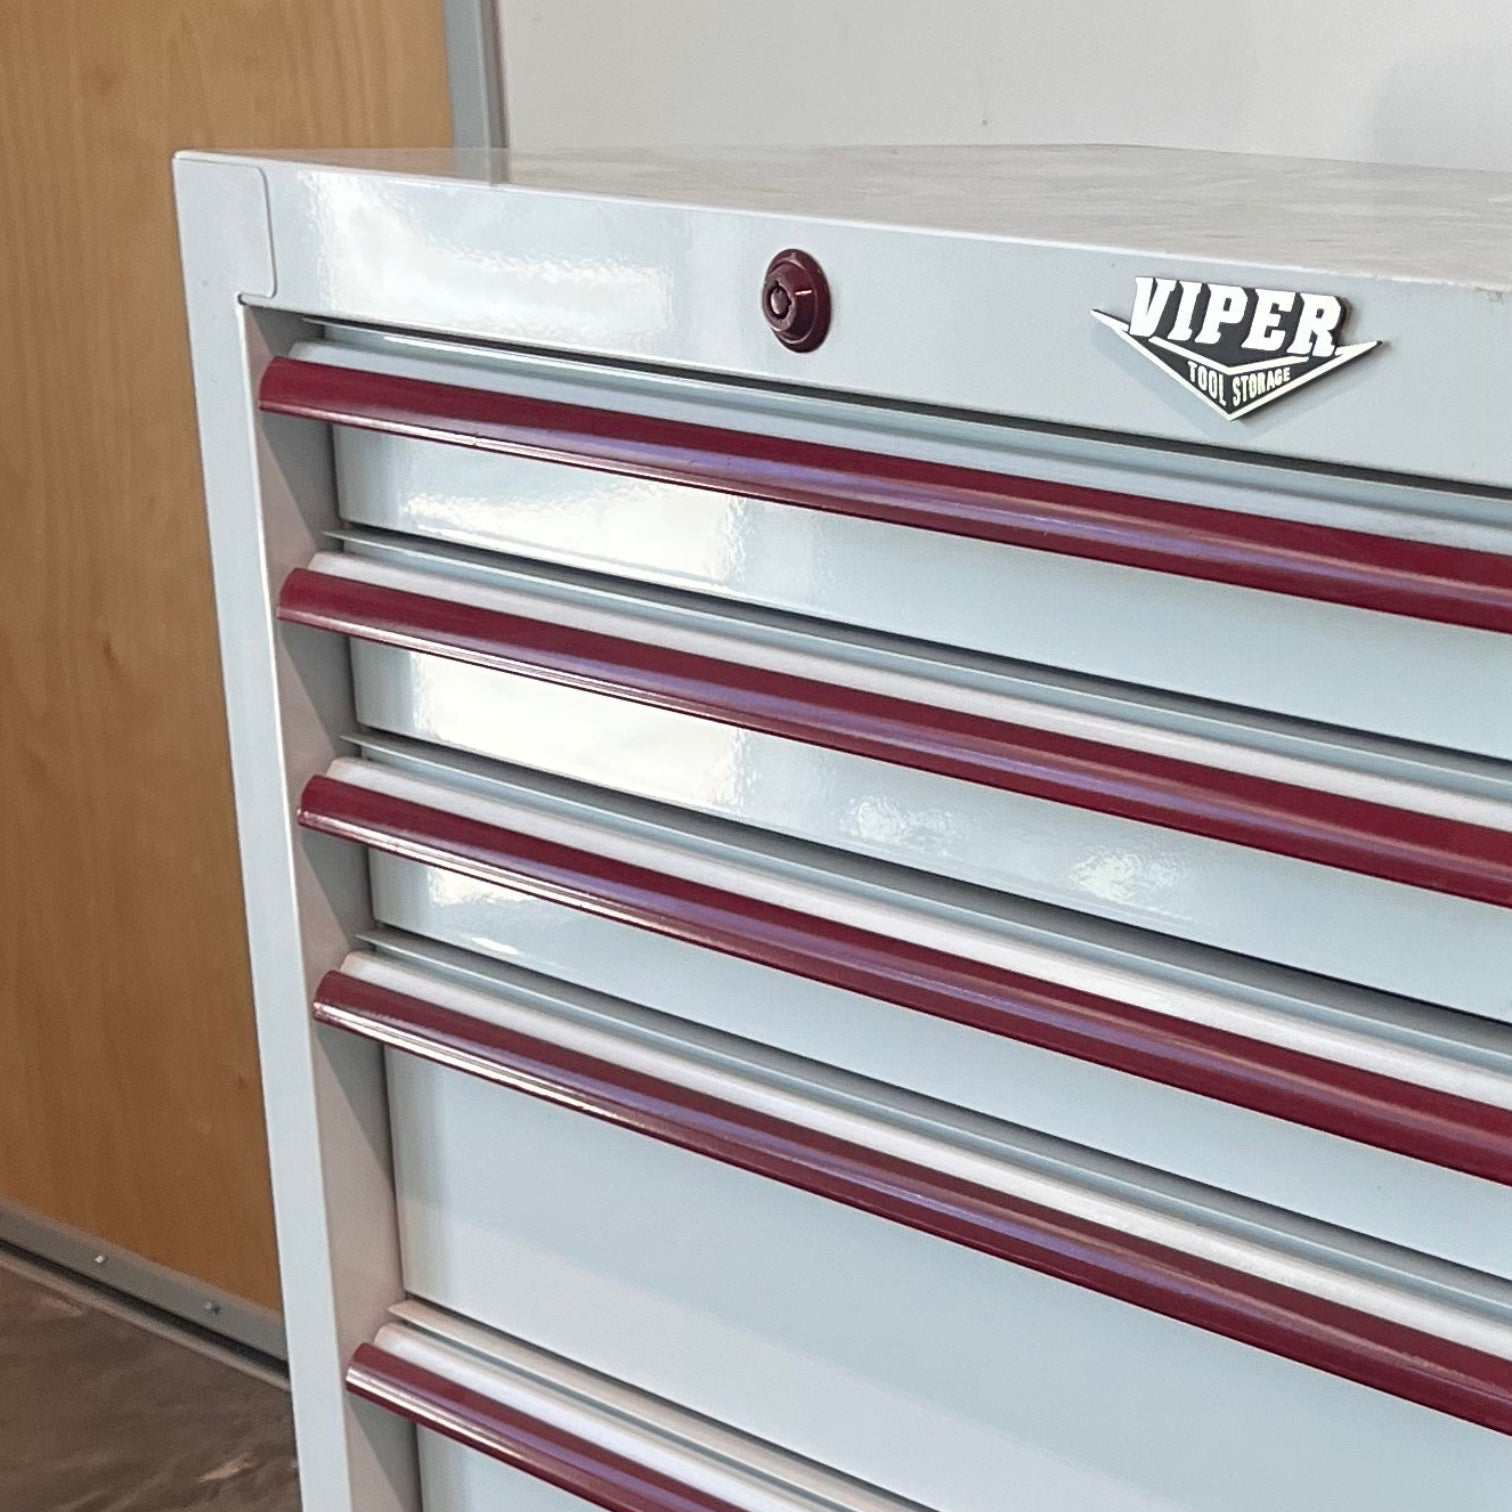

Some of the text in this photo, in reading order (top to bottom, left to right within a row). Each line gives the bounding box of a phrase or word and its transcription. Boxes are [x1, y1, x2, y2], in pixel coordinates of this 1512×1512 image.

[1130, 277, 1342, 357] VIPER
[1188, 360, 1291, 407] TOOL STORAGE
